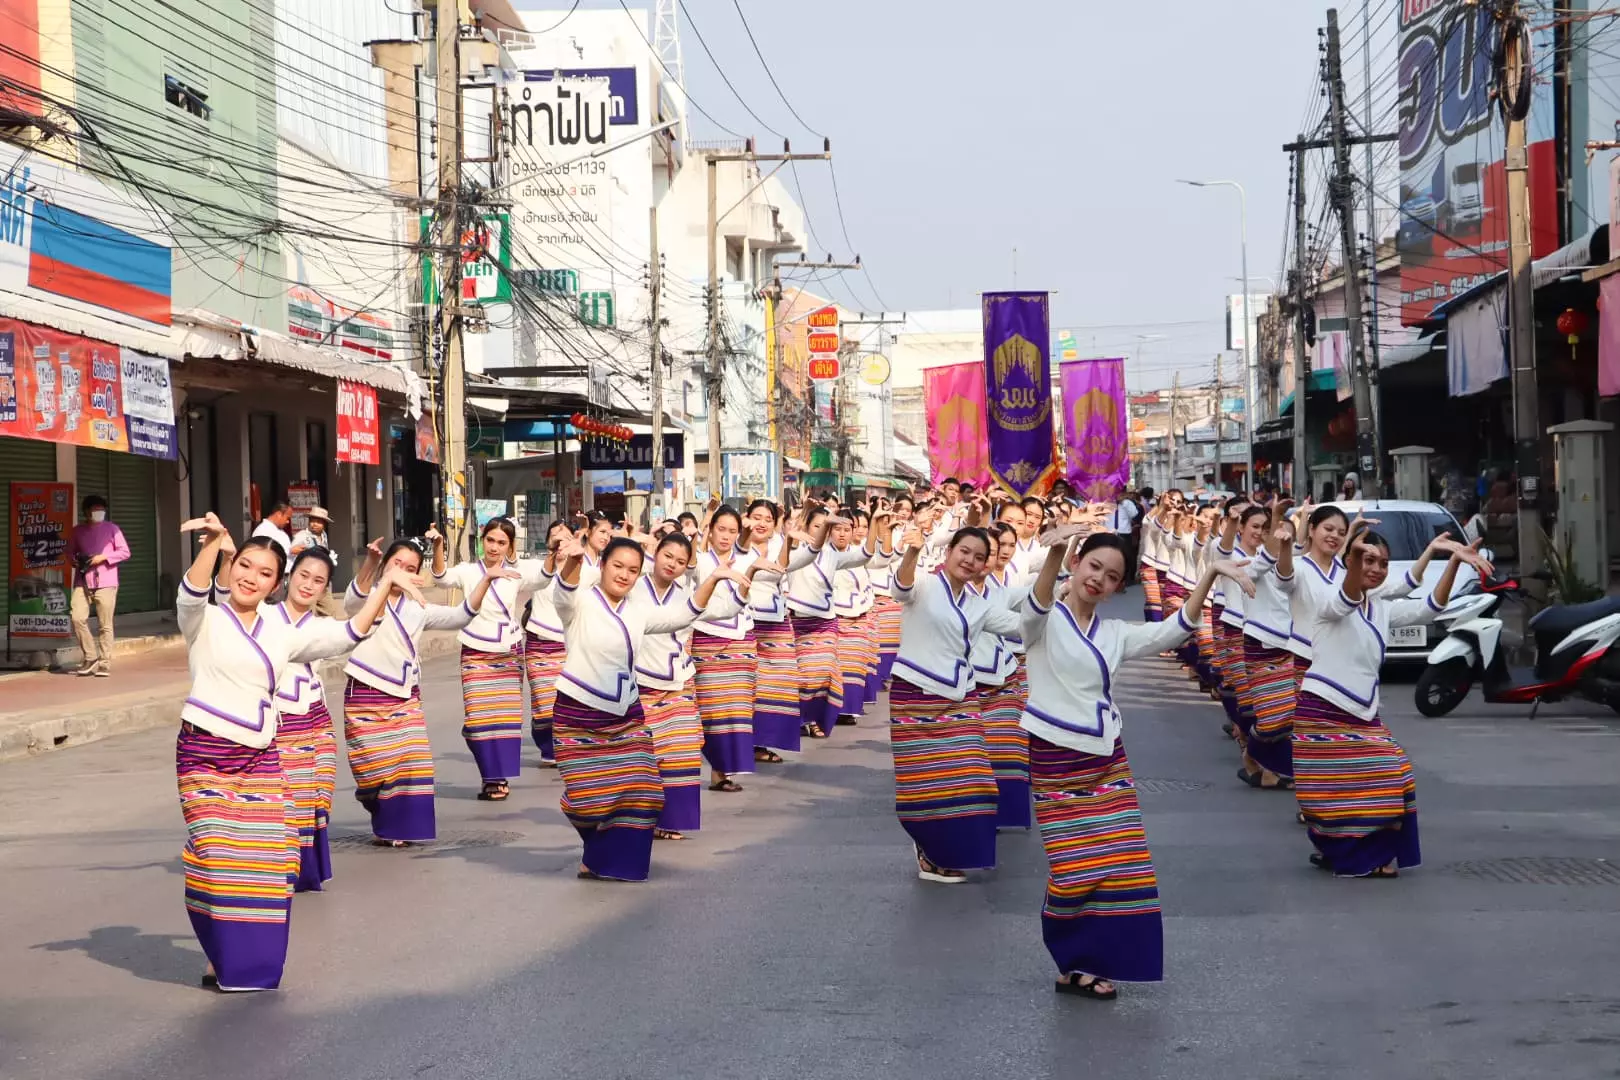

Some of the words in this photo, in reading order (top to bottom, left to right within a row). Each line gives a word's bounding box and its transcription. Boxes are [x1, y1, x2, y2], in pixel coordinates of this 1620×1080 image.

[511, 85, 606, 145] ทำฟัน
[569, 186, 577, 196] 3
[35, 540, 49, 557] 2
[1400, 628, 1421, 637] 6851
